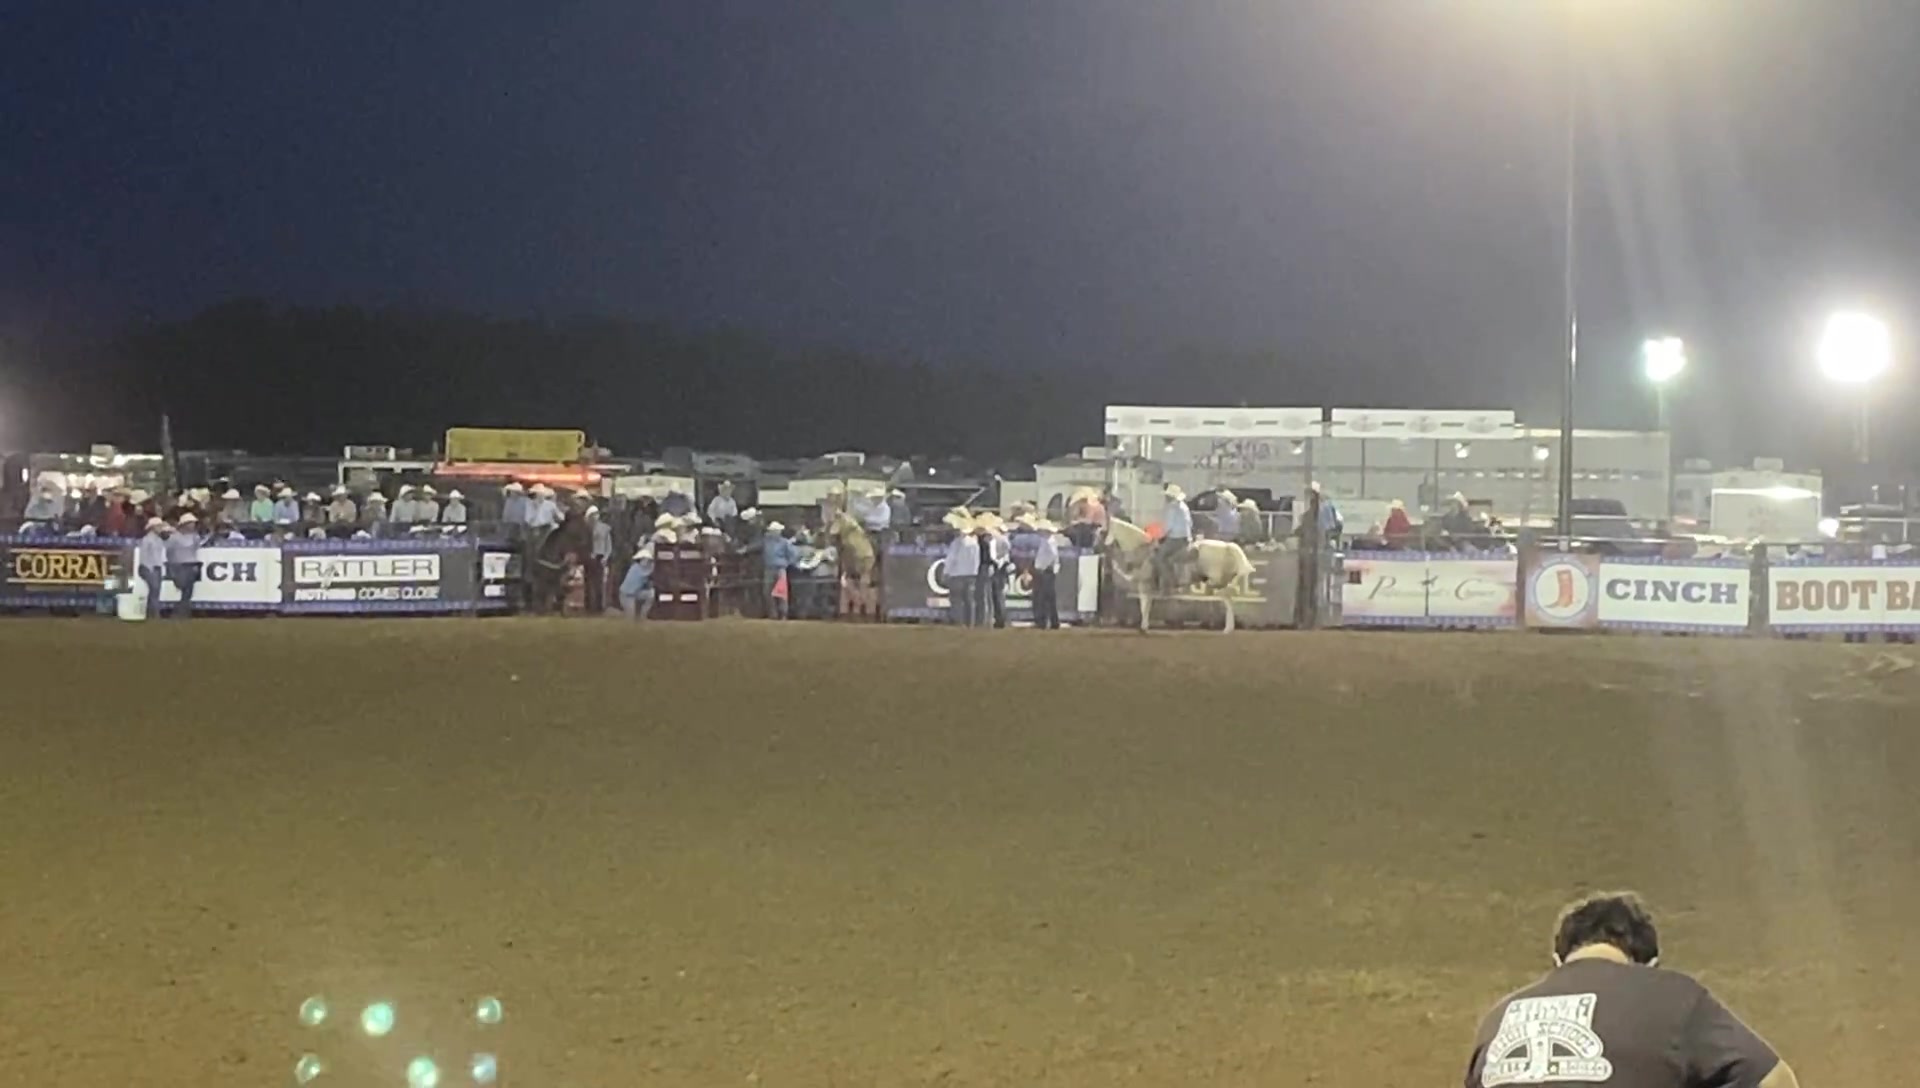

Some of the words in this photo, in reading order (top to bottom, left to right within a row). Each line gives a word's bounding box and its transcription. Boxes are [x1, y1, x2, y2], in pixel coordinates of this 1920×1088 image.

[15, 553, 110, 578] CORRAL
[301, 559, 433, 578] RATTLER
[1605, 578, 1738, 604] CINCH
[1775, 580, 1877, 611] BOOT
